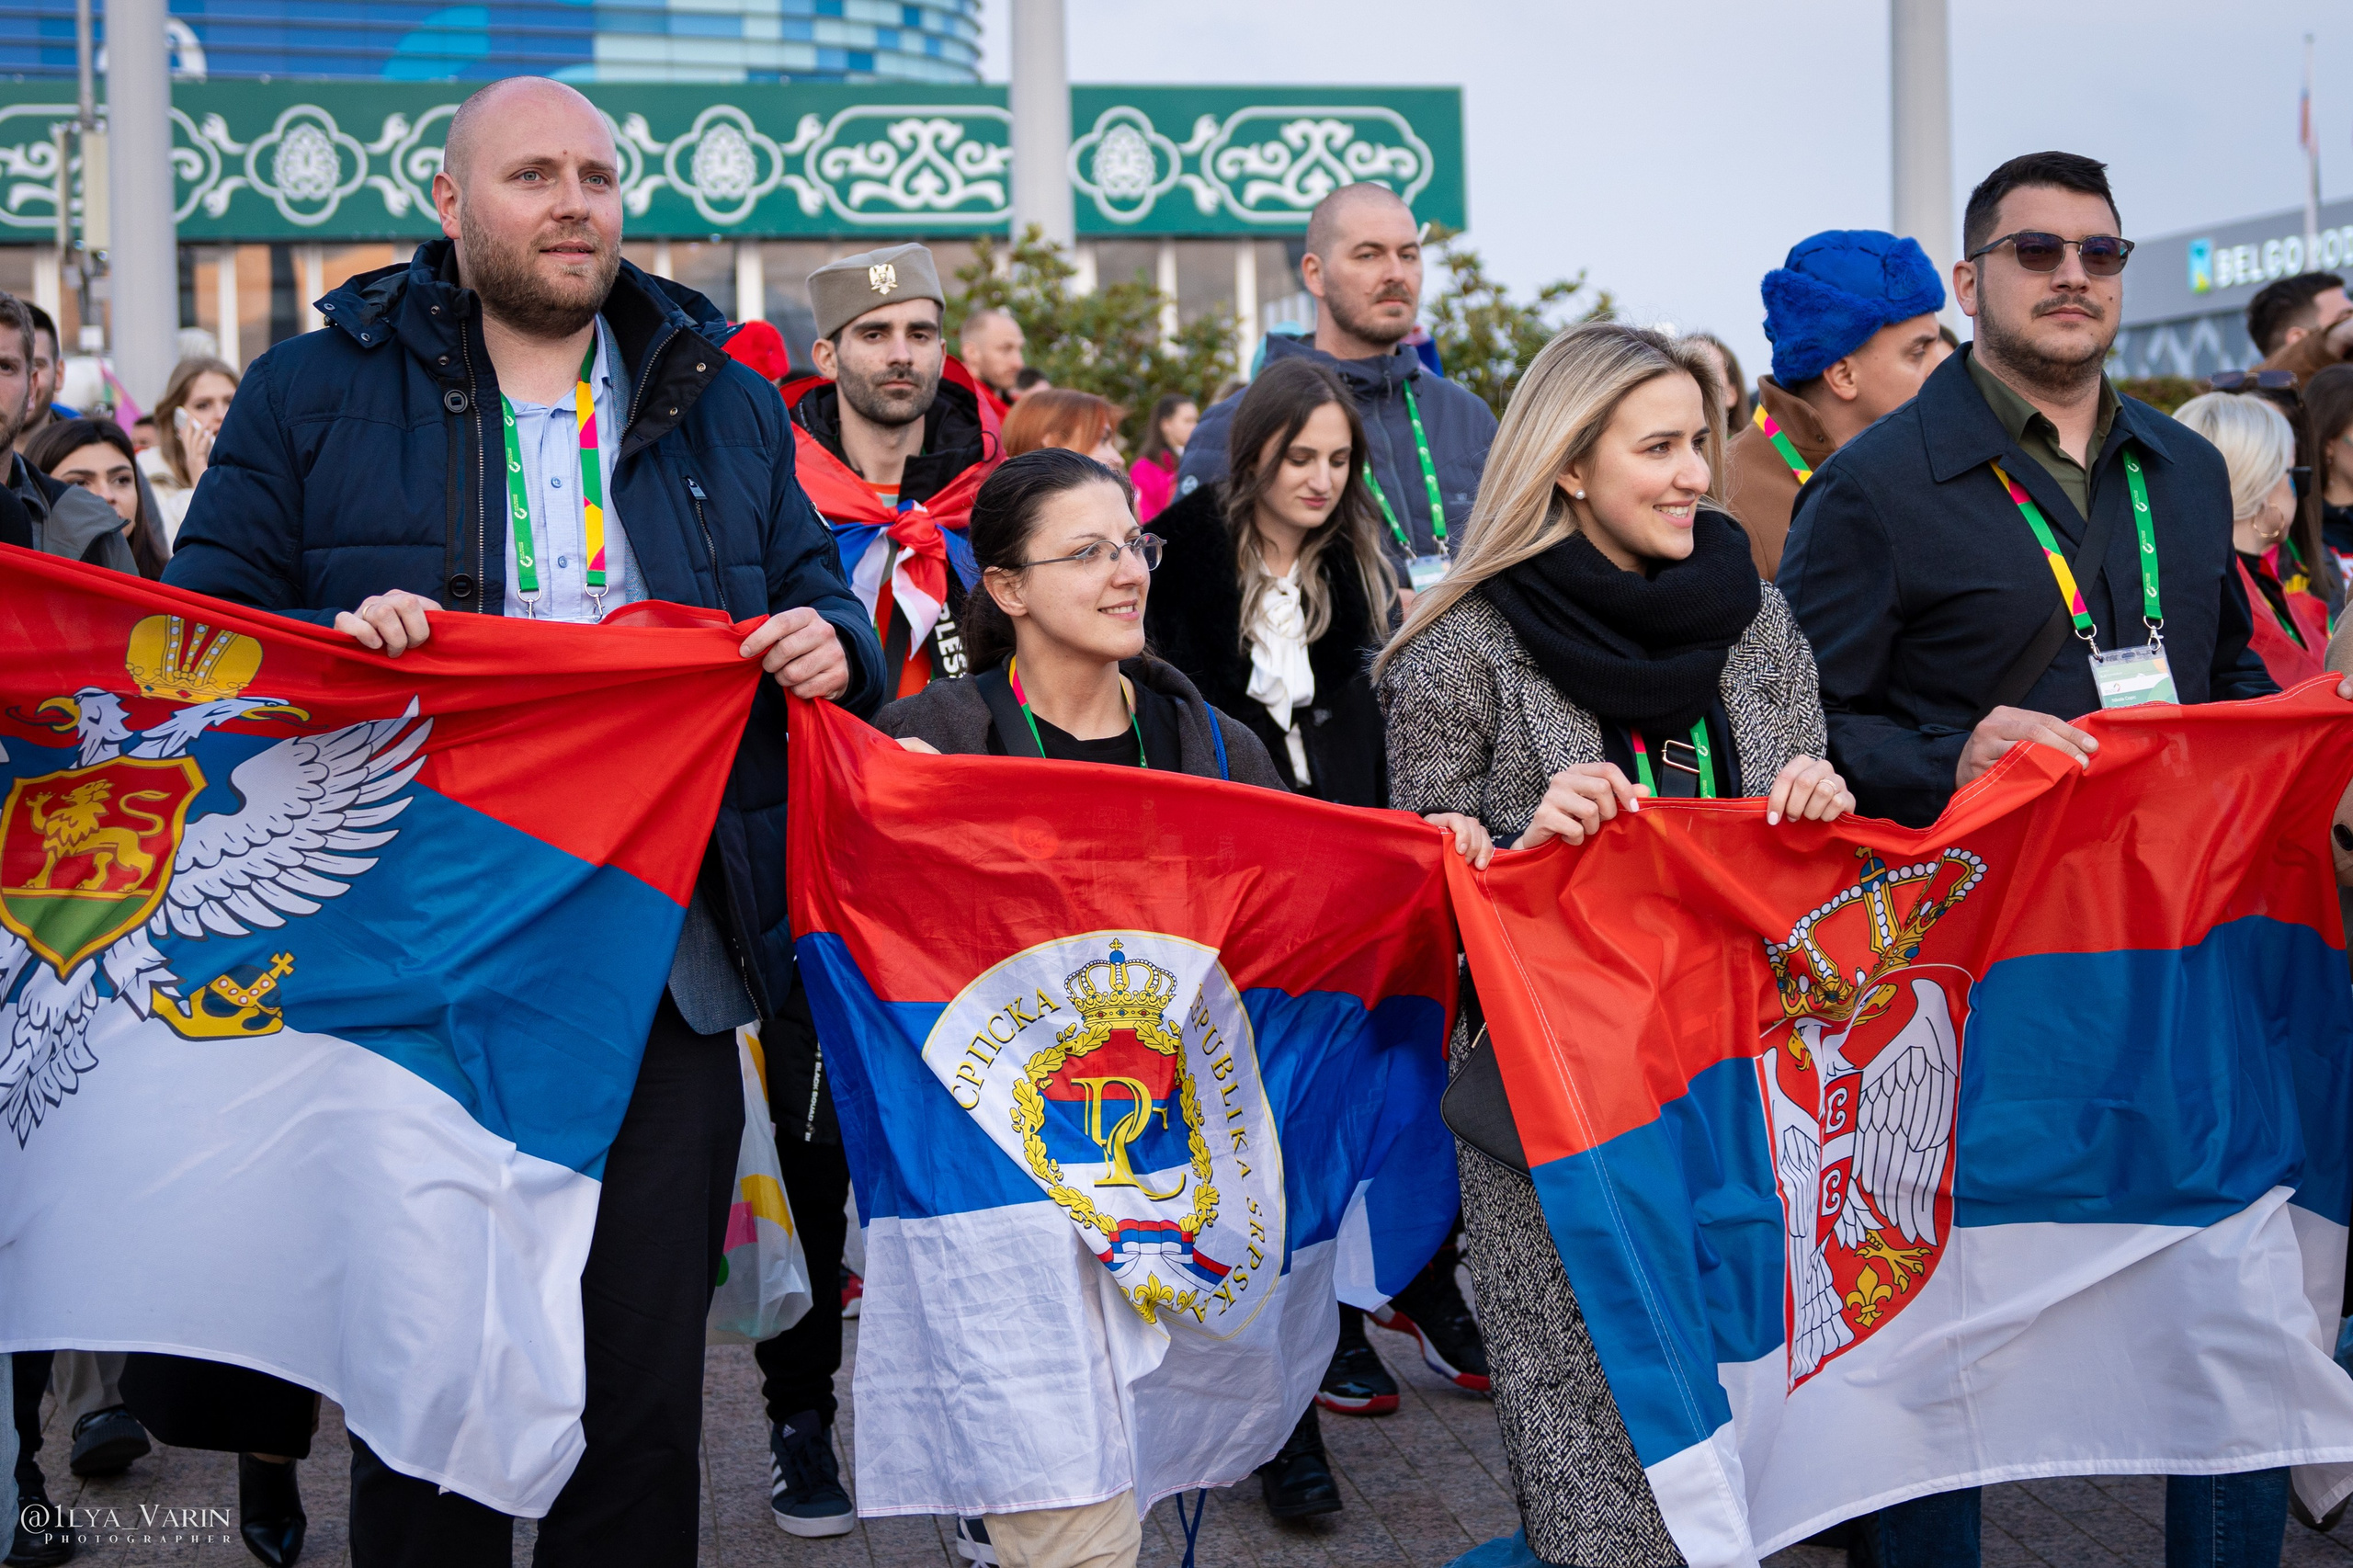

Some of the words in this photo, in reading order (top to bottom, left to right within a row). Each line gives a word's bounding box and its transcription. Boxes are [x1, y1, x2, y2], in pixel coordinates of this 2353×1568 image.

[813, 1062, 822, 1090] BLACK
[951, 987, 1062, 1111] СРПСКА
[1189, 983, 1252, 1181] EPUBLIKA
[1189, 1196, 1266, 1324] SRPSKA
